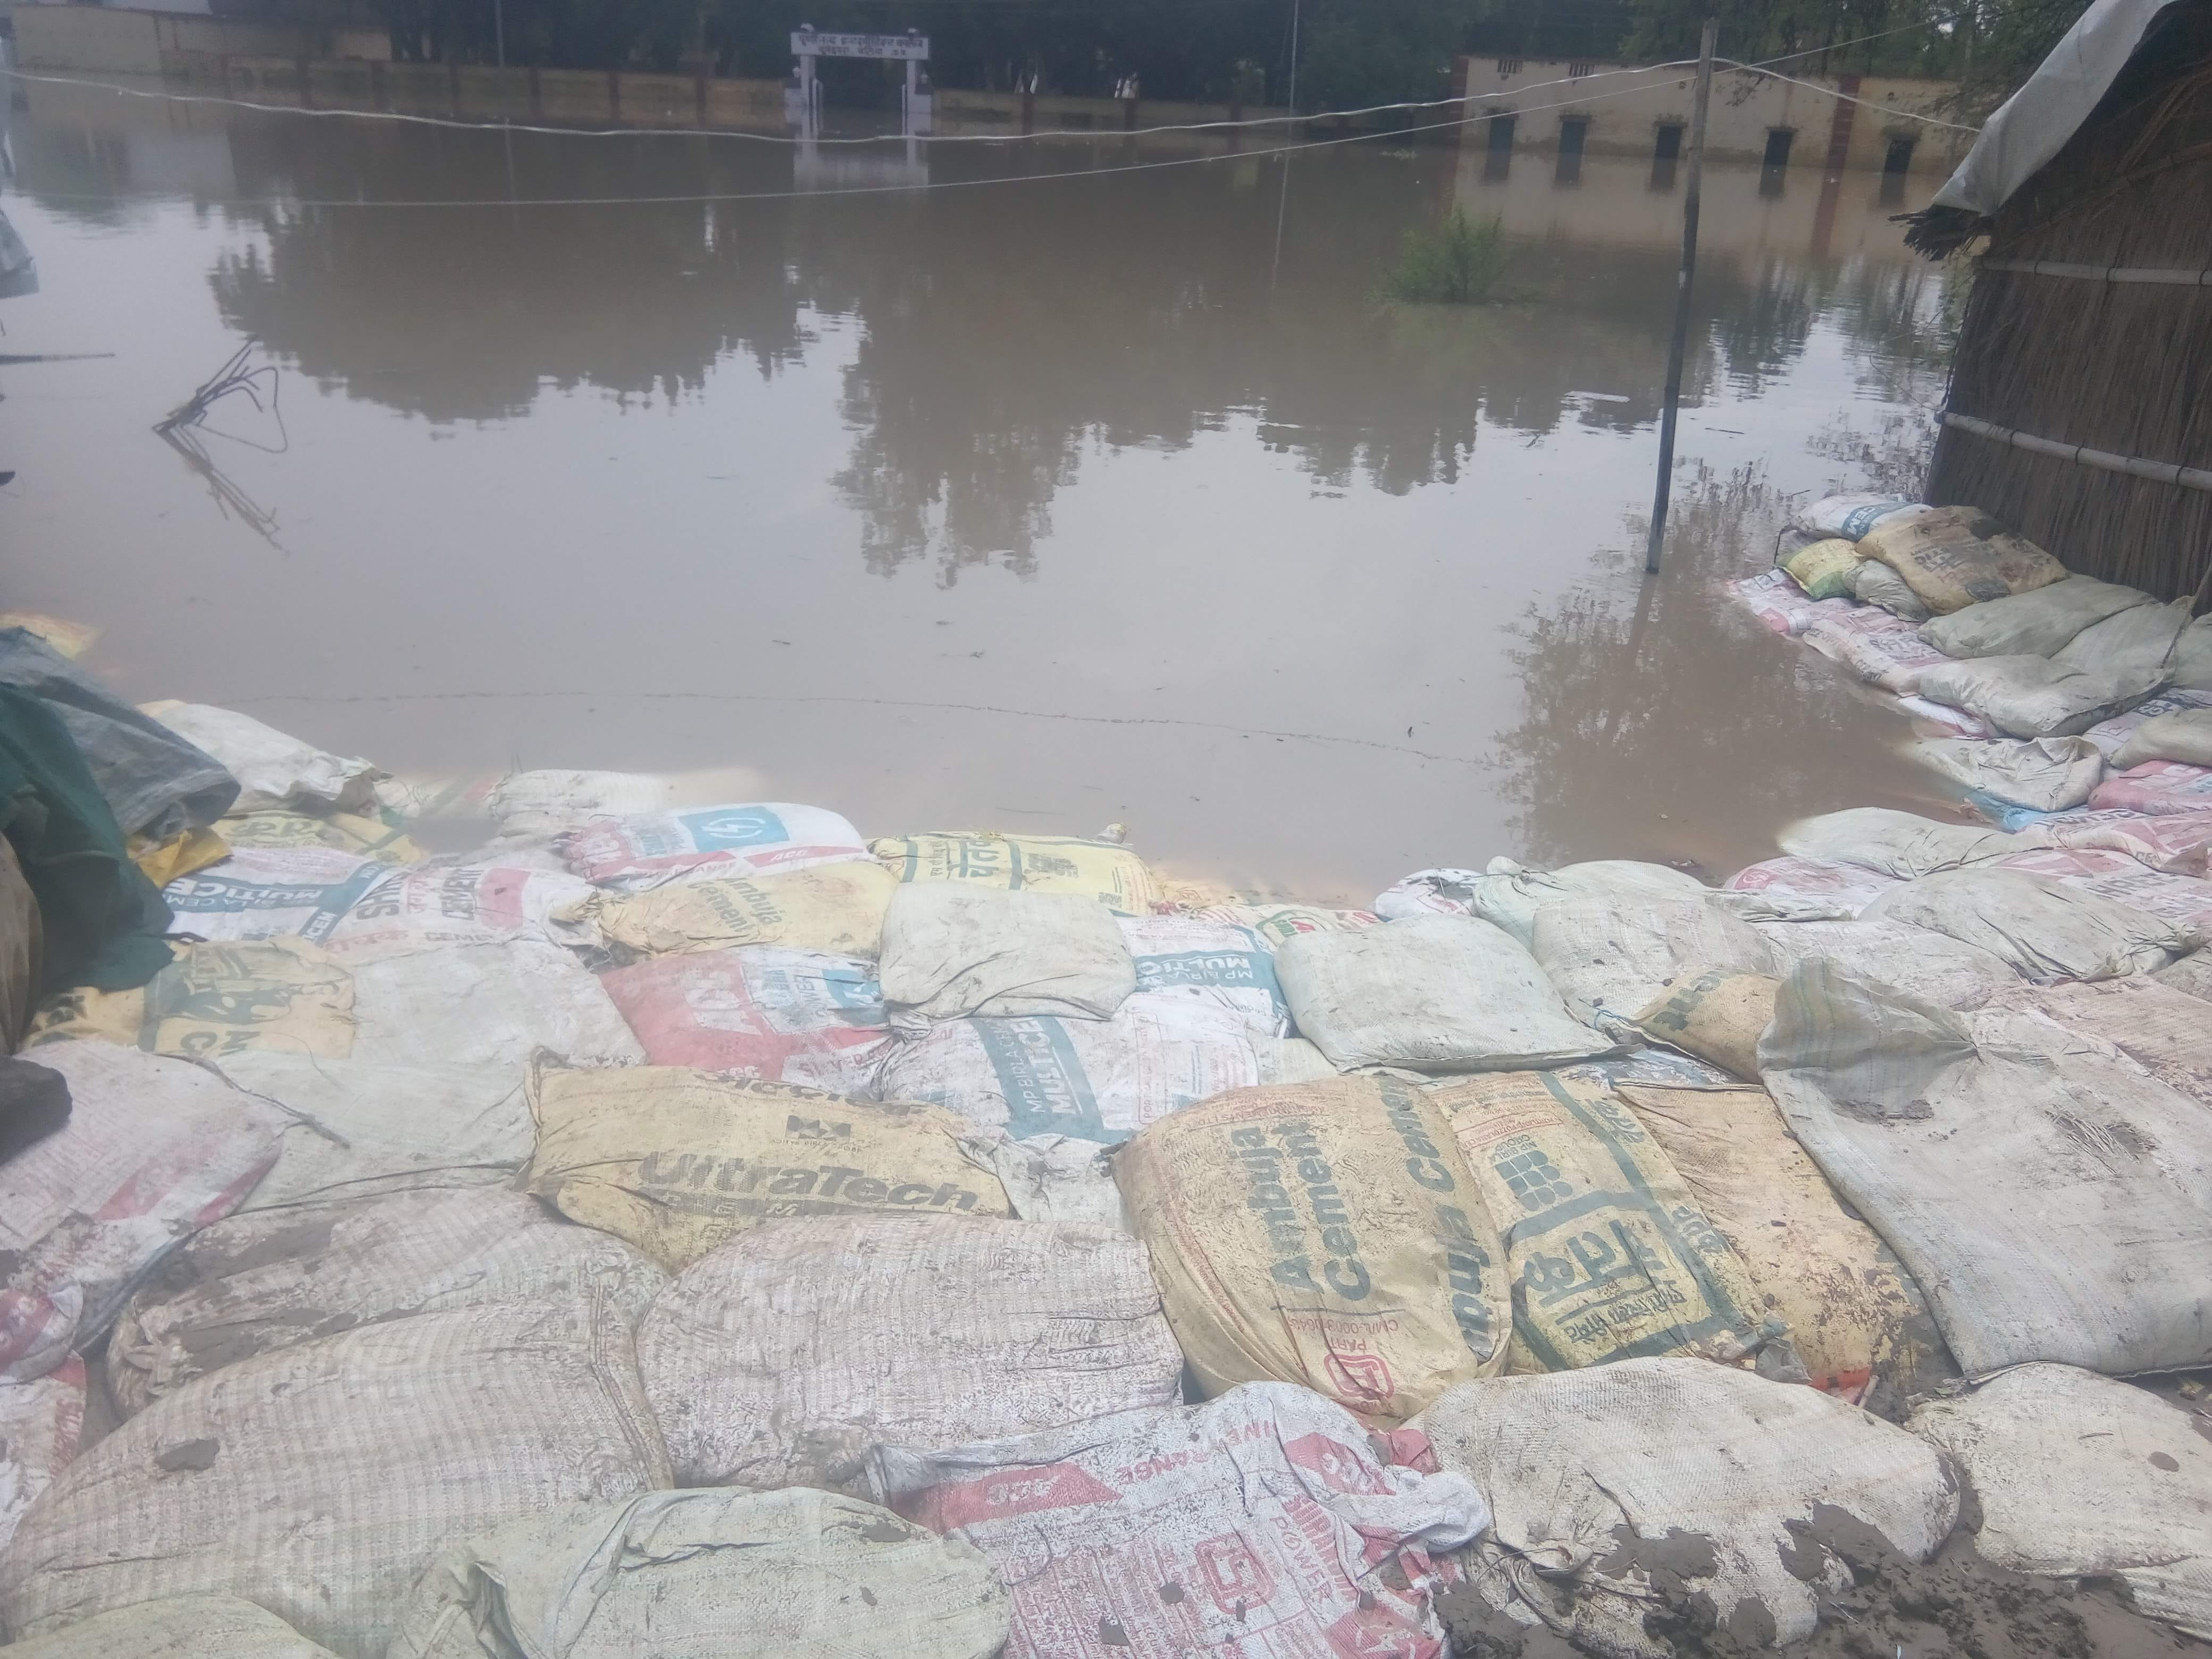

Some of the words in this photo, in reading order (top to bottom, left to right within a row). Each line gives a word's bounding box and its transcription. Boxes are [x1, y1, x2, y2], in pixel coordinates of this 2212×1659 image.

[1225, 969, 1254, 979] MP
[1020, 1087, 1045, 1116] MP
[1492, 1134, 1530, 1153] GROUP
[1519, 1140, 1538, 1153] MP
[640, 1150, 978, 1209] UltraTech
[1231, 1126, 1325, 1295] Ambuja
[1276, 1121, 1371, 1301] Cement
[1269, 1513, 1336, 1605] POWER
